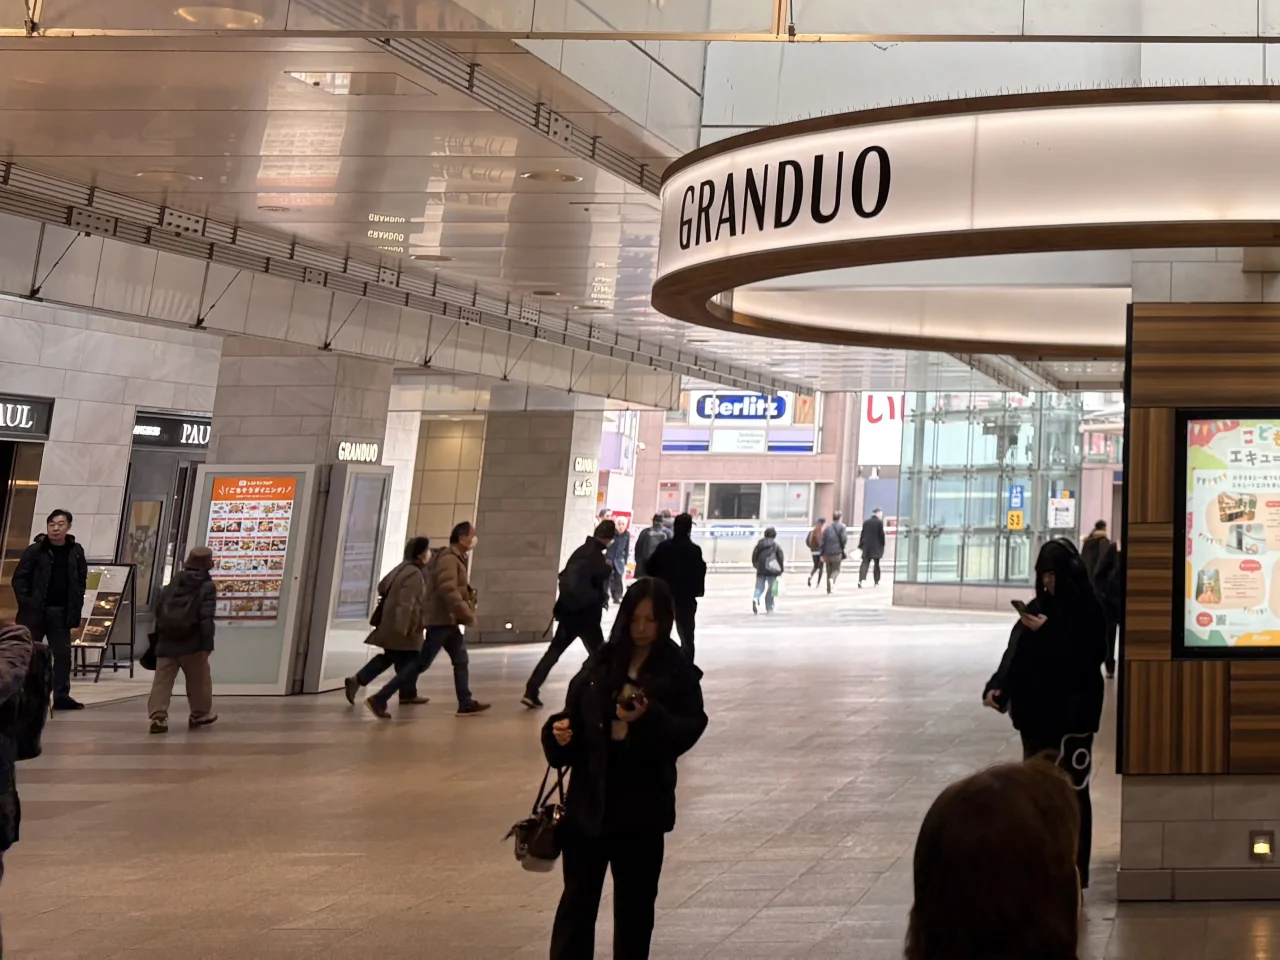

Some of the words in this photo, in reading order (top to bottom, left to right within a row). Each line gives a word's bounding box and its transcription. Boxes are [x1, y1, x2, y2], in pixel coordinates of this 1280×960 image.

[679, 146, 891, 250] GRANDUO
[704, 397, 778, 416] Berlitz
[338, 441, 379, 462] GRANDUO
